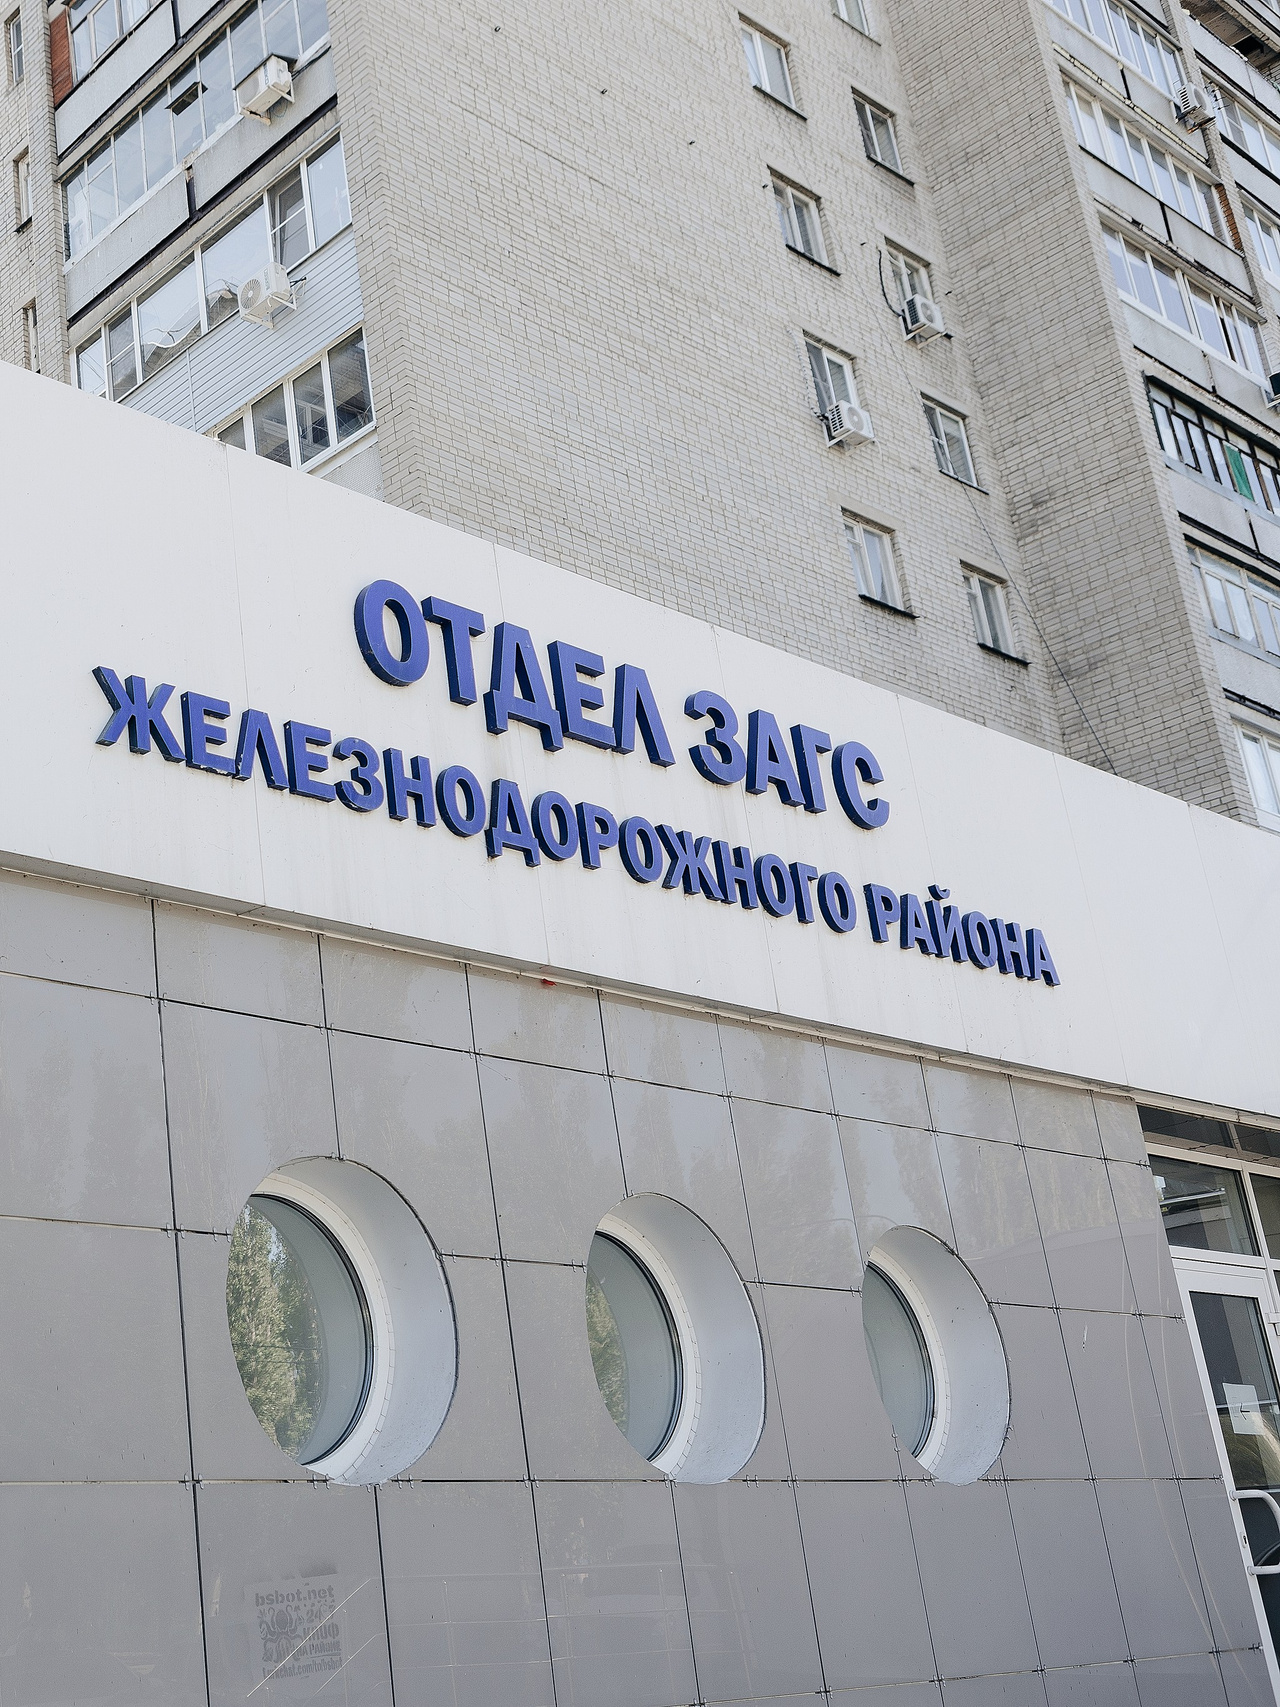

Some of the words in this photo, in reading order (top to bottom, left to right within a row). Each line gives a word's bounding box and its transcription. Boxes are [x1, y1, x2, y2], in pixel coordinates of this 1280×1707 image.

[91, 665, 857, 933] ЖЕЛЕЗНОДОРОЖНОГО
[863, 883, 1060, 986] РАЙОНА
[355, 579, 675, 769] ОТДЕЛ
[683, 689, 890, 831] ЗАГС
[255, 1585, 335, 1607] bsbot.net
